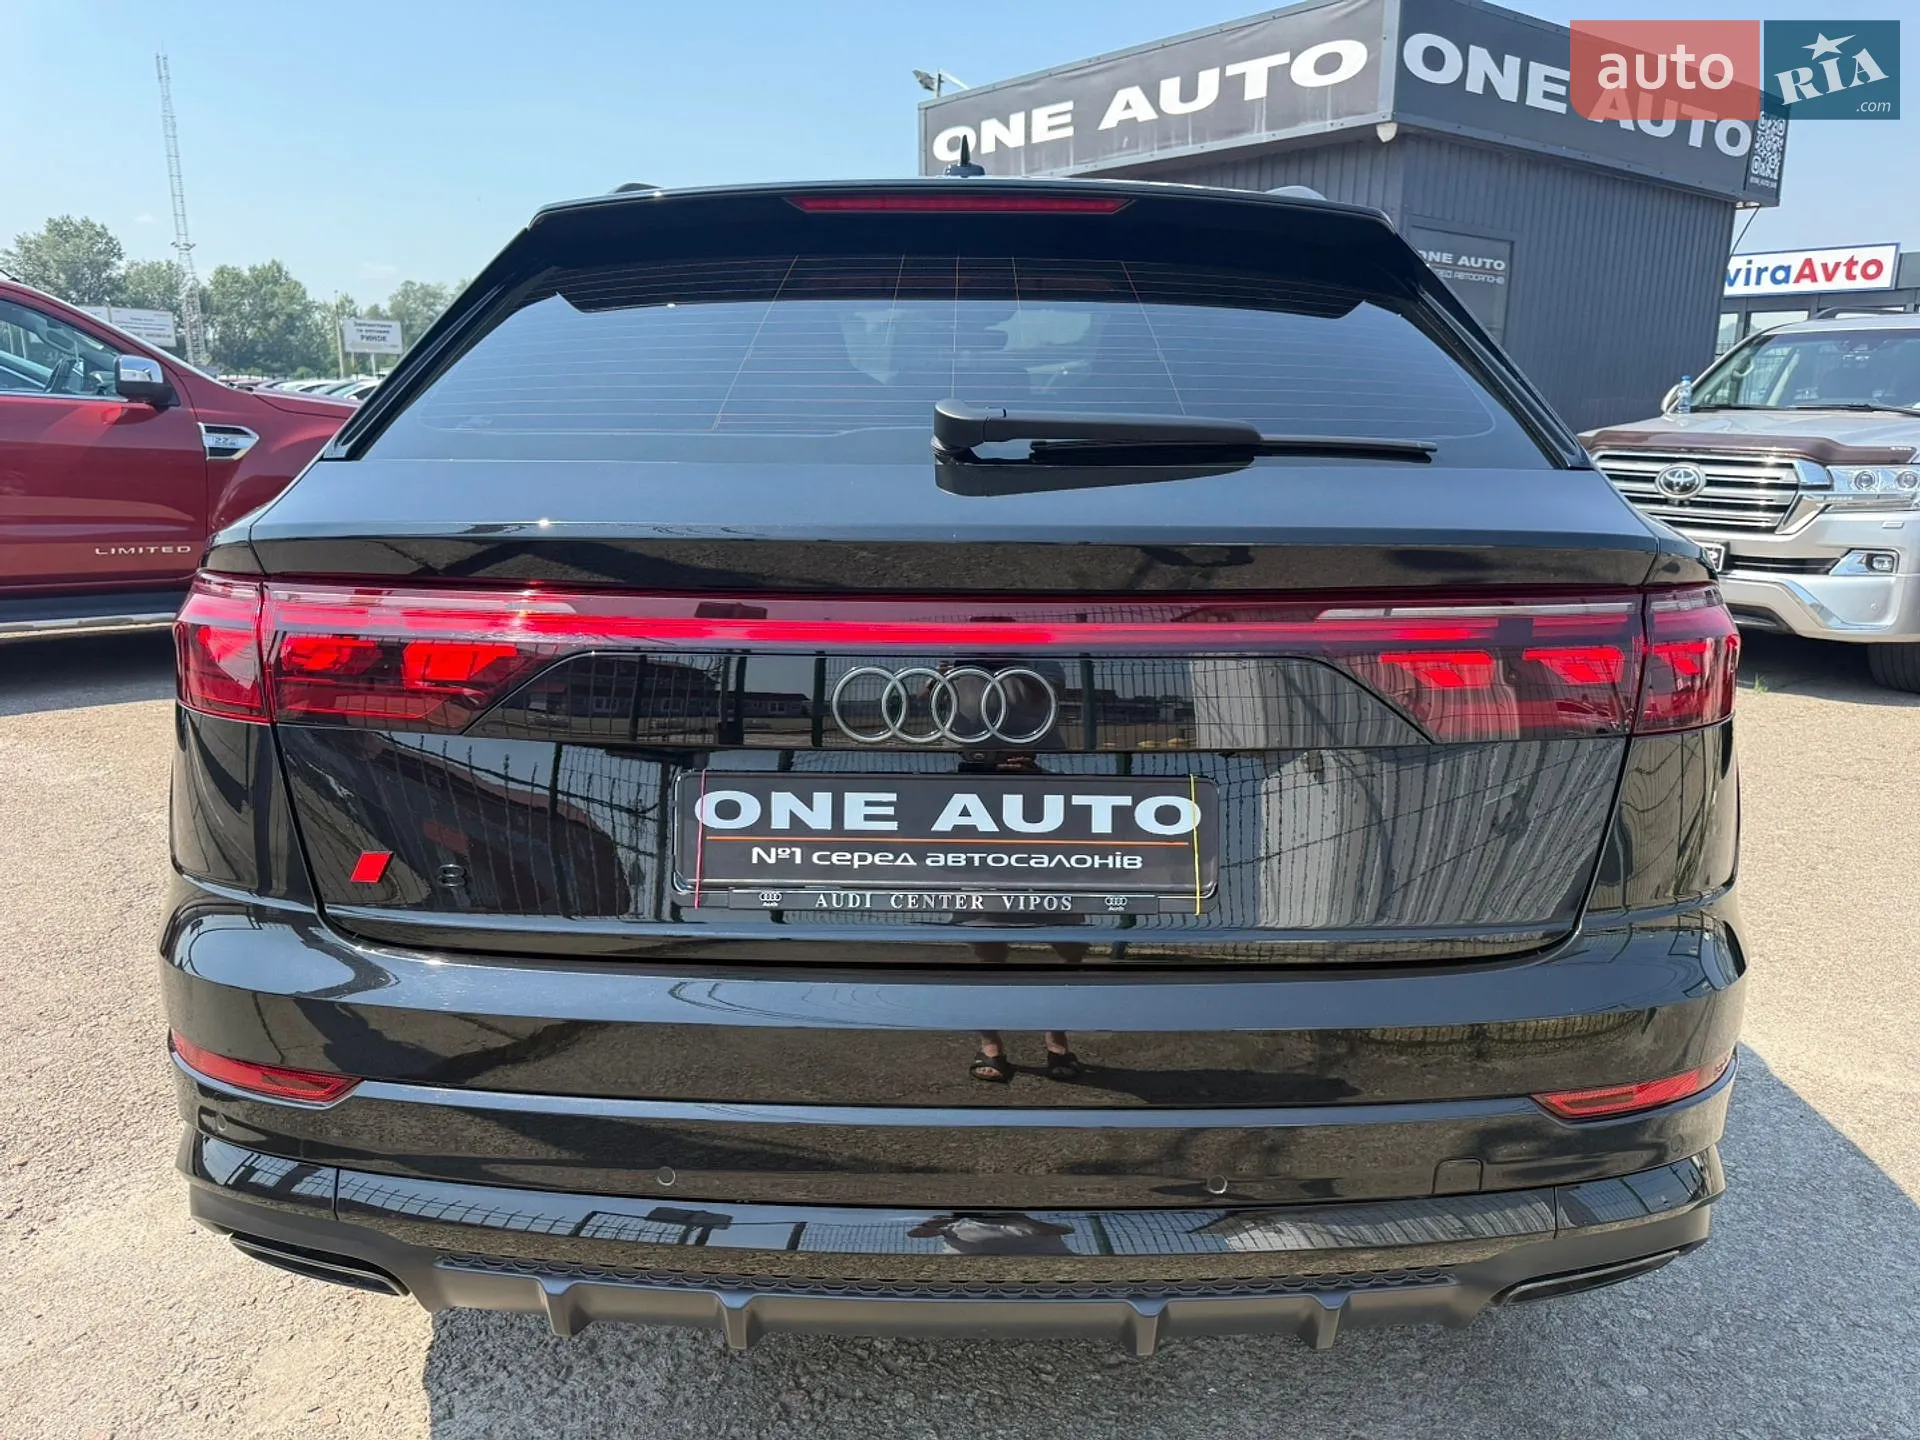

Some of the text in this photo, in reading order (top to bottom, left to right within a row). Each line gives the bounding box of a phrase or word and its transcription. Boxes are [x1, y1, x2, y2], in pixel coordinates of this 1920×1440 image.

[932, 39, 1368, 162] ONE AUTO
[1402, 33, 1751, 157] ONE AUTO
[1457, 255, 1505, 270] AUTO
[1725, 255, 1884, 287] viraAvto
[95, 546, 191, 554] LIMITED
[695, 790, 1201, 835] ONE AUTO
[812, 851, 917, 869] серед
[925, 851, 1143, 869] автосалонів
[815, 893, 1072, 911] AUDI CENTER VIPOS
